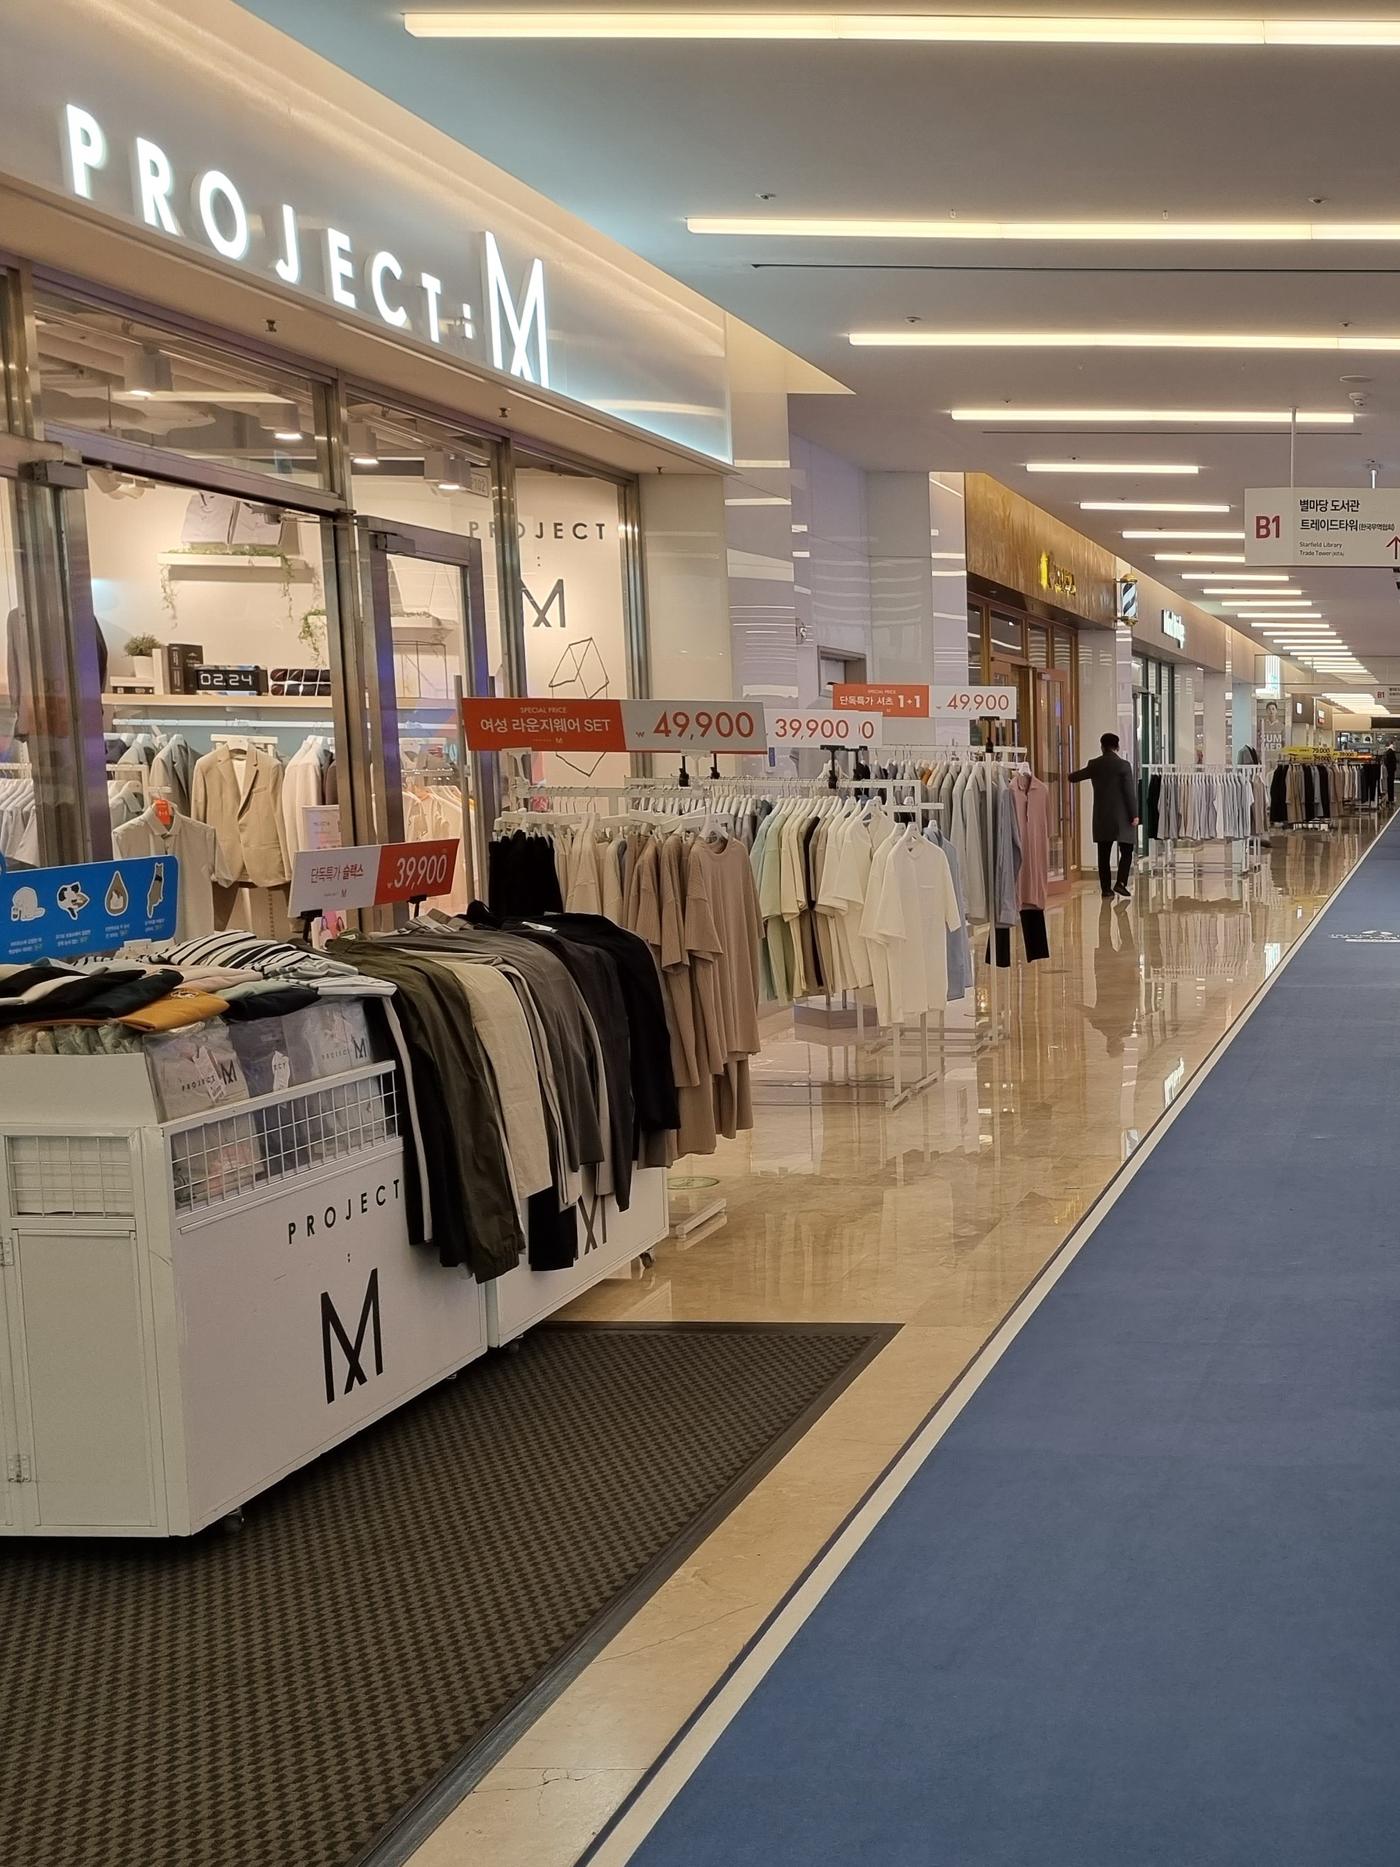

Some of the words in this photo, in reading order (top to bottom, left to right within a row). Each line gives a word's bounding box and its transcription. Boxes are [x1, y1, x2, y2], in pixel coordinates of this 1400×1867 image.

[483, 229, 551, 390] M
[1300, 499, 1328, 512] 별마당
[1330, 499, 1360, 512] 도서관
[1255, 515, 1281, 539] B1
[1299, 541, 1322, 549] Starfield
[1323, 541, 1343, 549] Library
[947, 693, 1010, 712] 49,900
[480, 717, 508, 733] 여성
[512, 717, 580, 733] 라운지웨어
[583, 718, 611, 732] SET
[653, 711, 755, 740] 49,900
[774, 718, 849, 740] 39,900
[394, 854, 448, 890] 39,900
[287, 1177, 400, 1245] PROJECT
